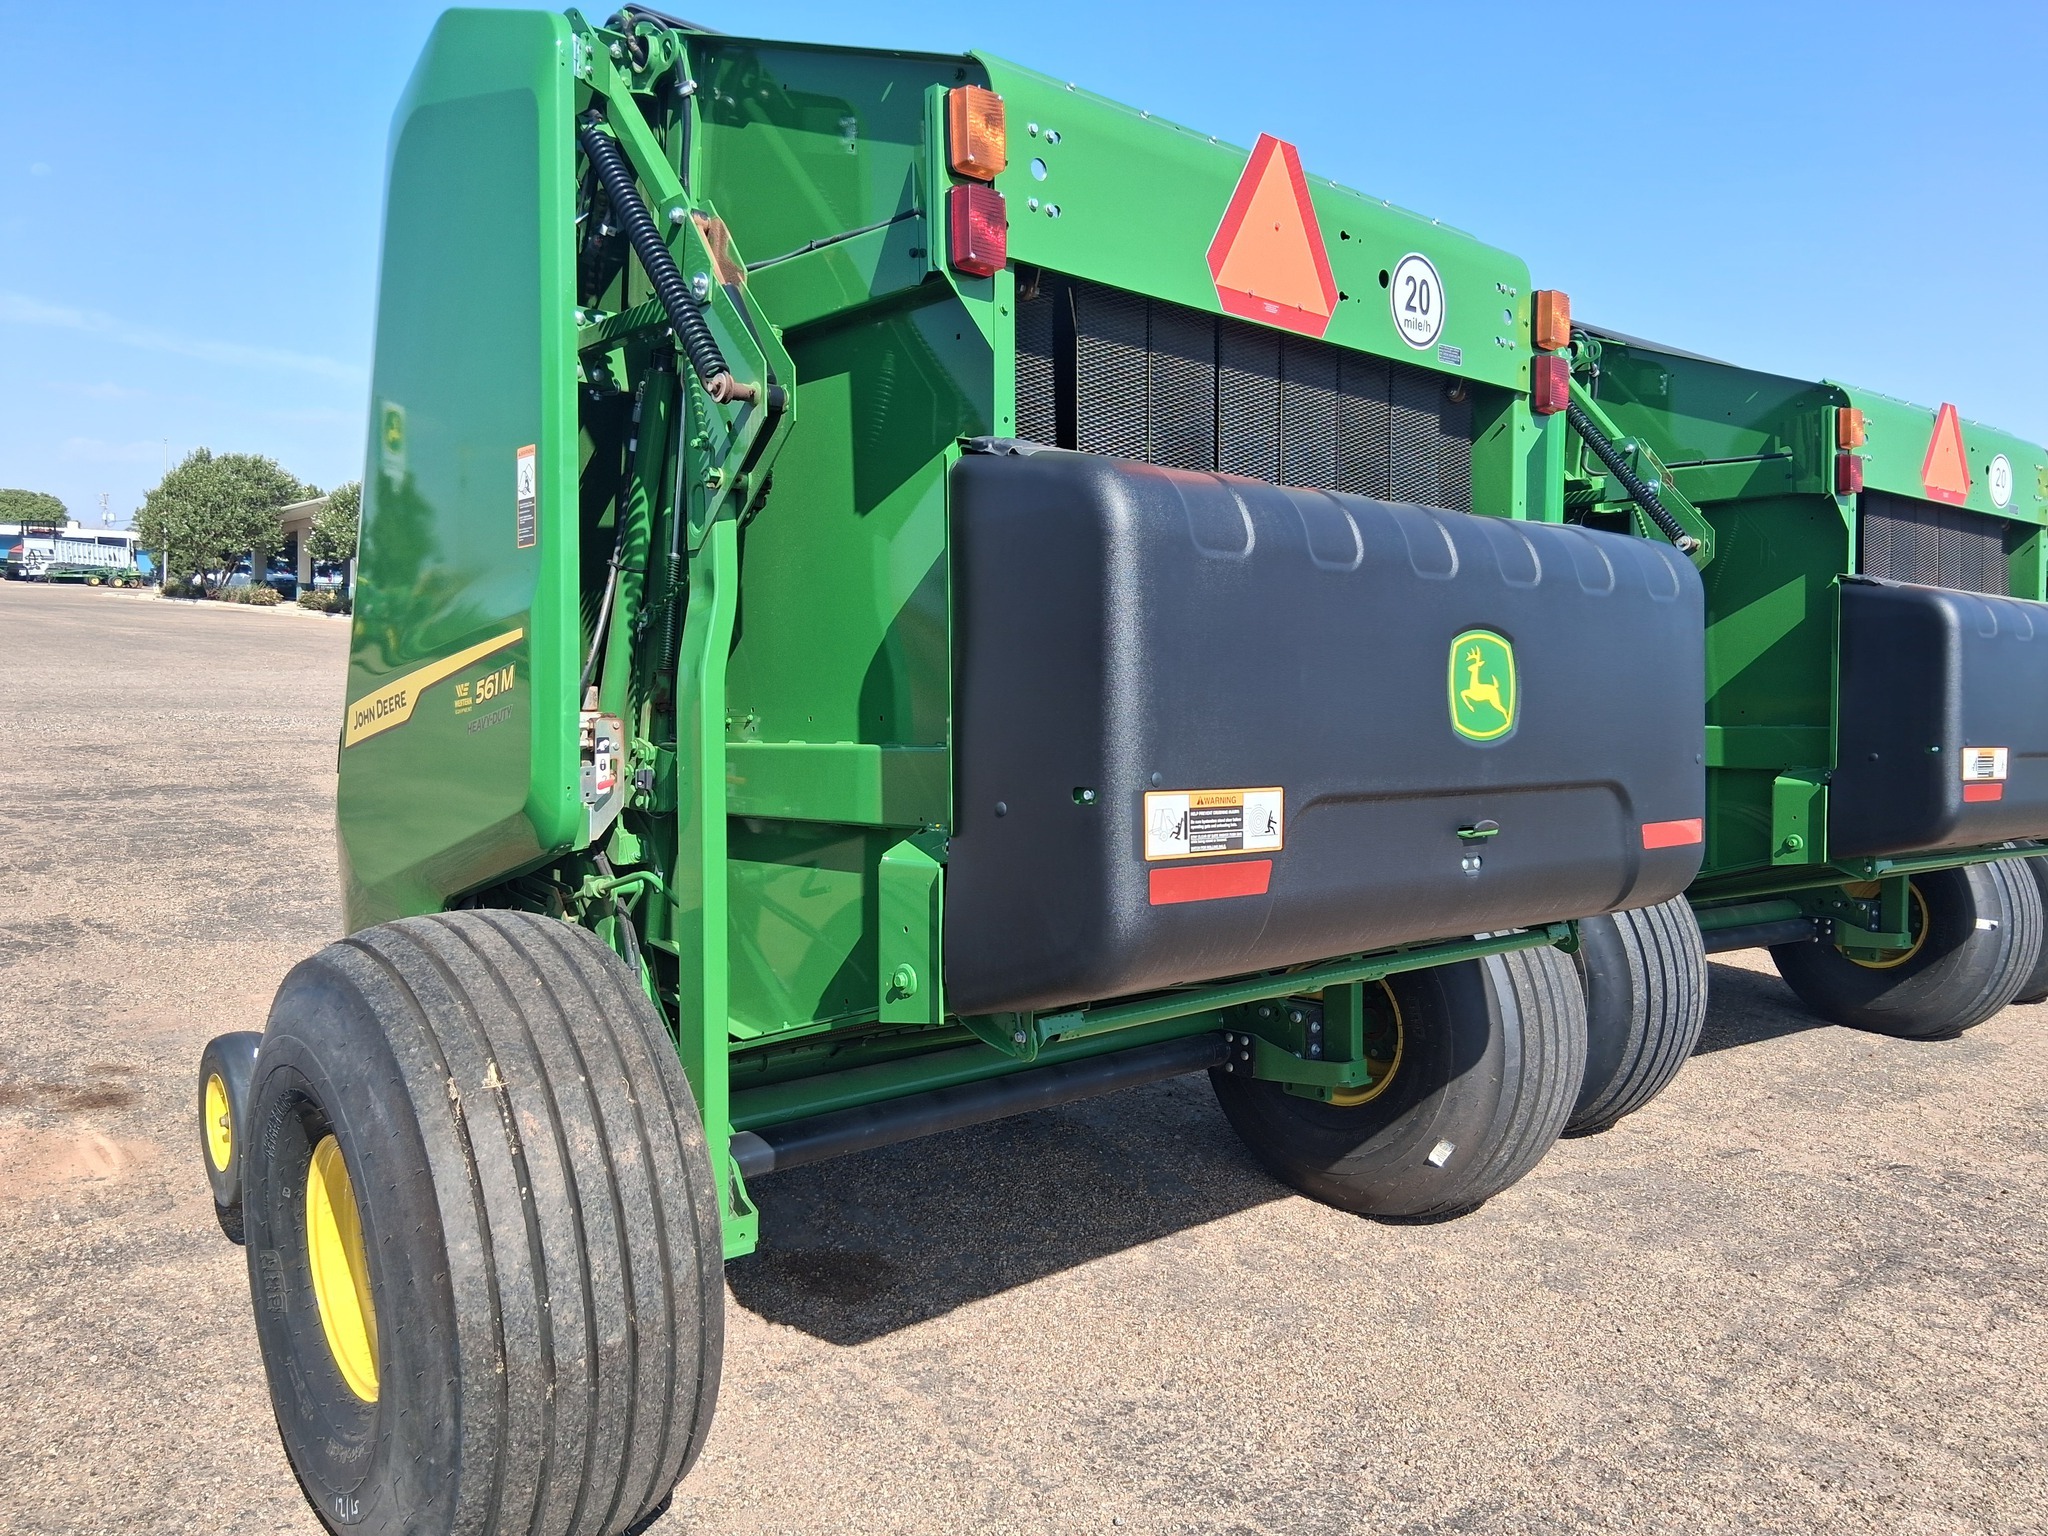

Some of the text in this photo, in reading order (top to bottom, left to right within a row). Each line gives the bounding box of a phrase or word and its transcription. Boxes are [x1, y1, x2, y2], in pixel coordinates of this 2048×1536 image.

[1405, 275, 1430, 316] 20
[1404, 317, 1431, 334] mile/h
[1996, 467, 2006, 488] 20
[354, 690, 407, 730] JOHN DEERE
[1204, 796, 1237, 805] WARNING
